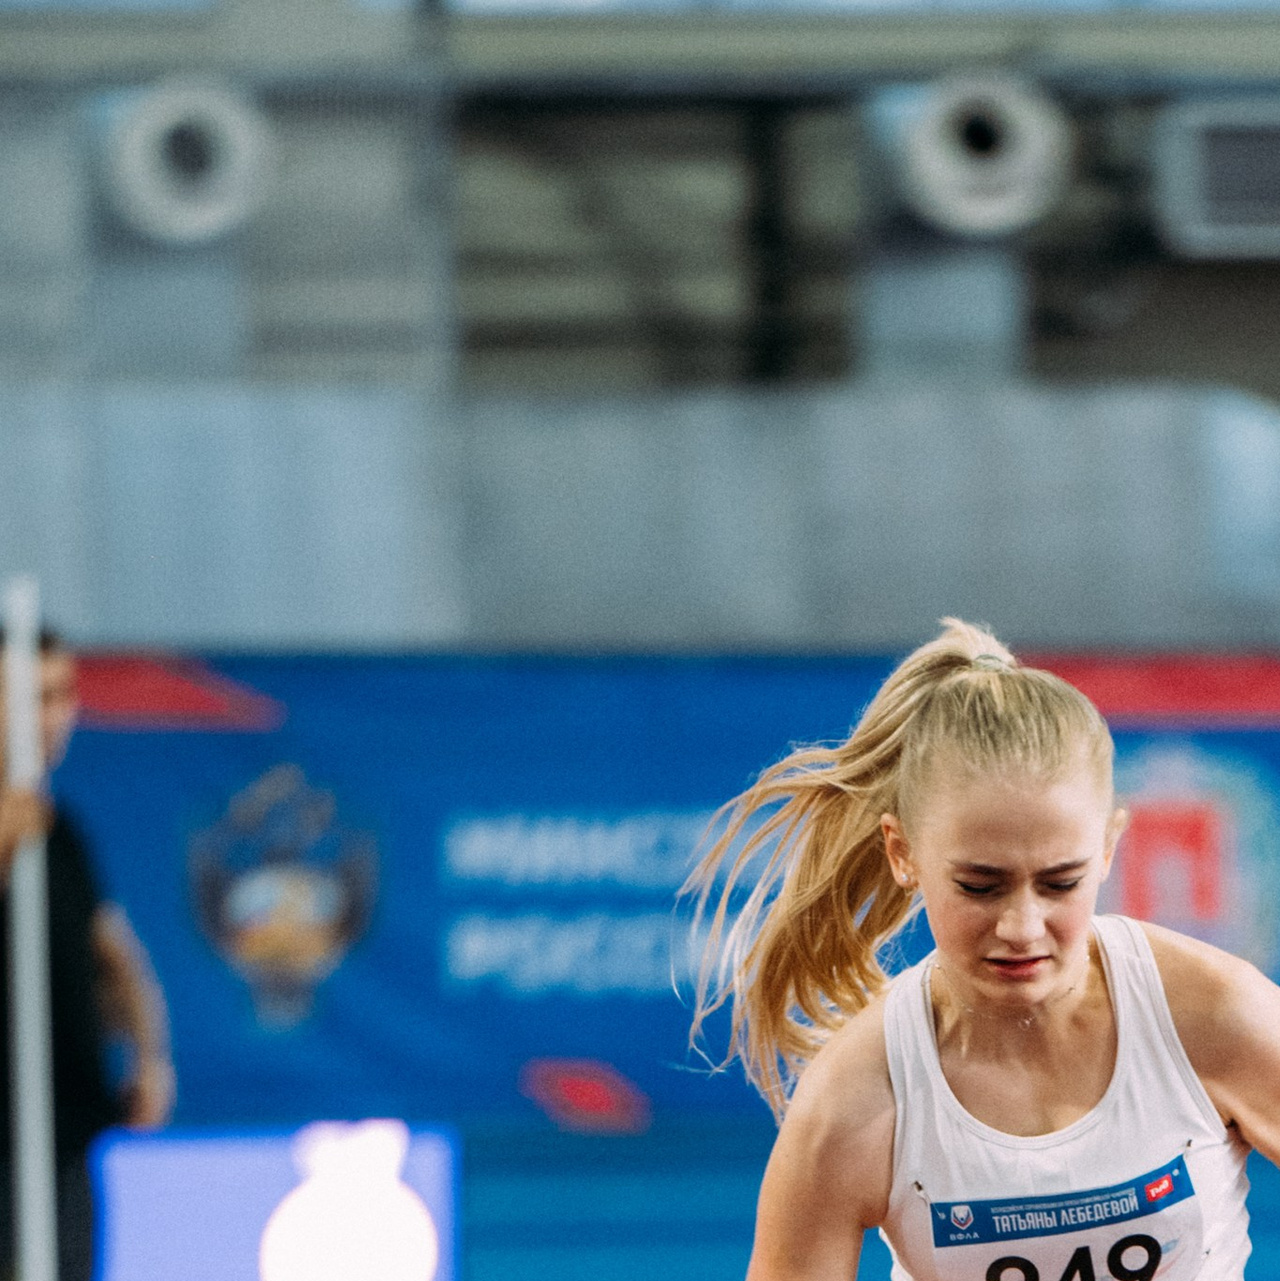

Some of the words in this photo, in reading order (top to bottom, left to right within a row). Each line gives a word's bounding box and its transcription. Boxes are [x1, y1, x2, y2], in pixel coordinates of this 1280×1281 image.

[992, 1211, 1058, 1233] ТАТЬЯНЫ
[1061, 1194, 1139, 1226] ЛЕБЕДЕВОЙ
[949, 1231, 980, 1241] ВФЛА
